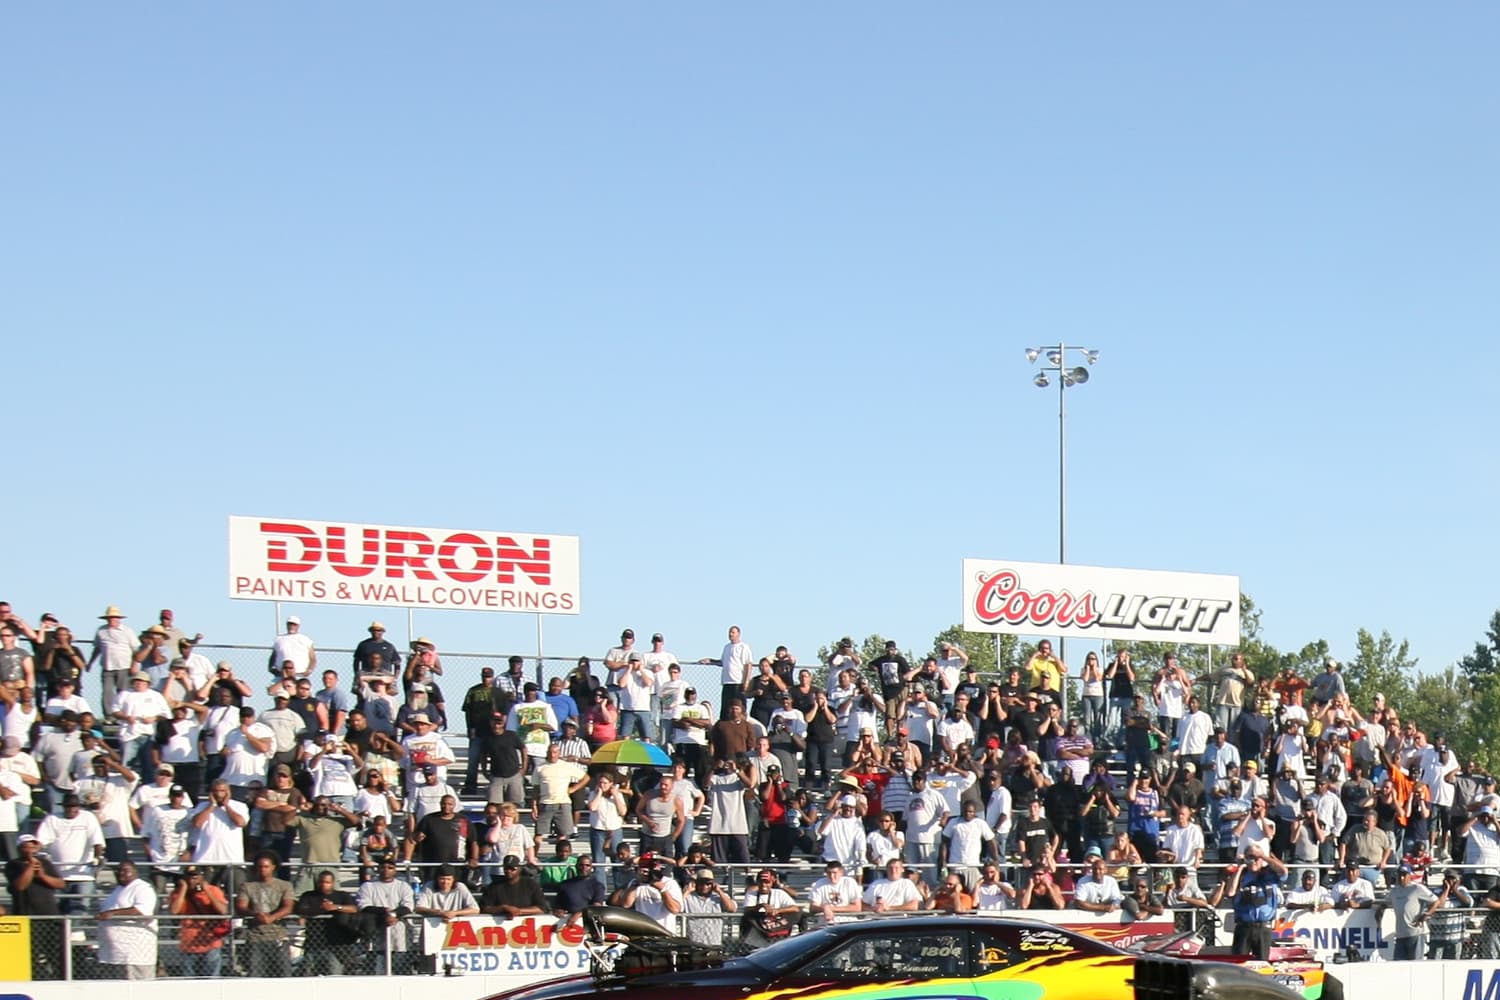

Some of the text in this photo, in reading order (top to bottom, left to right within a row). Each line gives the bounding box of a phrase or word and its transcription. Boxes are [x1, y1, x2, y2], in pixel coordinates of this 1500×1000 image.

[260, 522, 551, 586] DURON
[235, 576, 574, 610] PAINTS & WALLCOVERINGS
[975, 569, 1233, 633] Coors LIGHT
[441, 952, 500, 973] USED
[508, 949, 570, 971] AUTO
